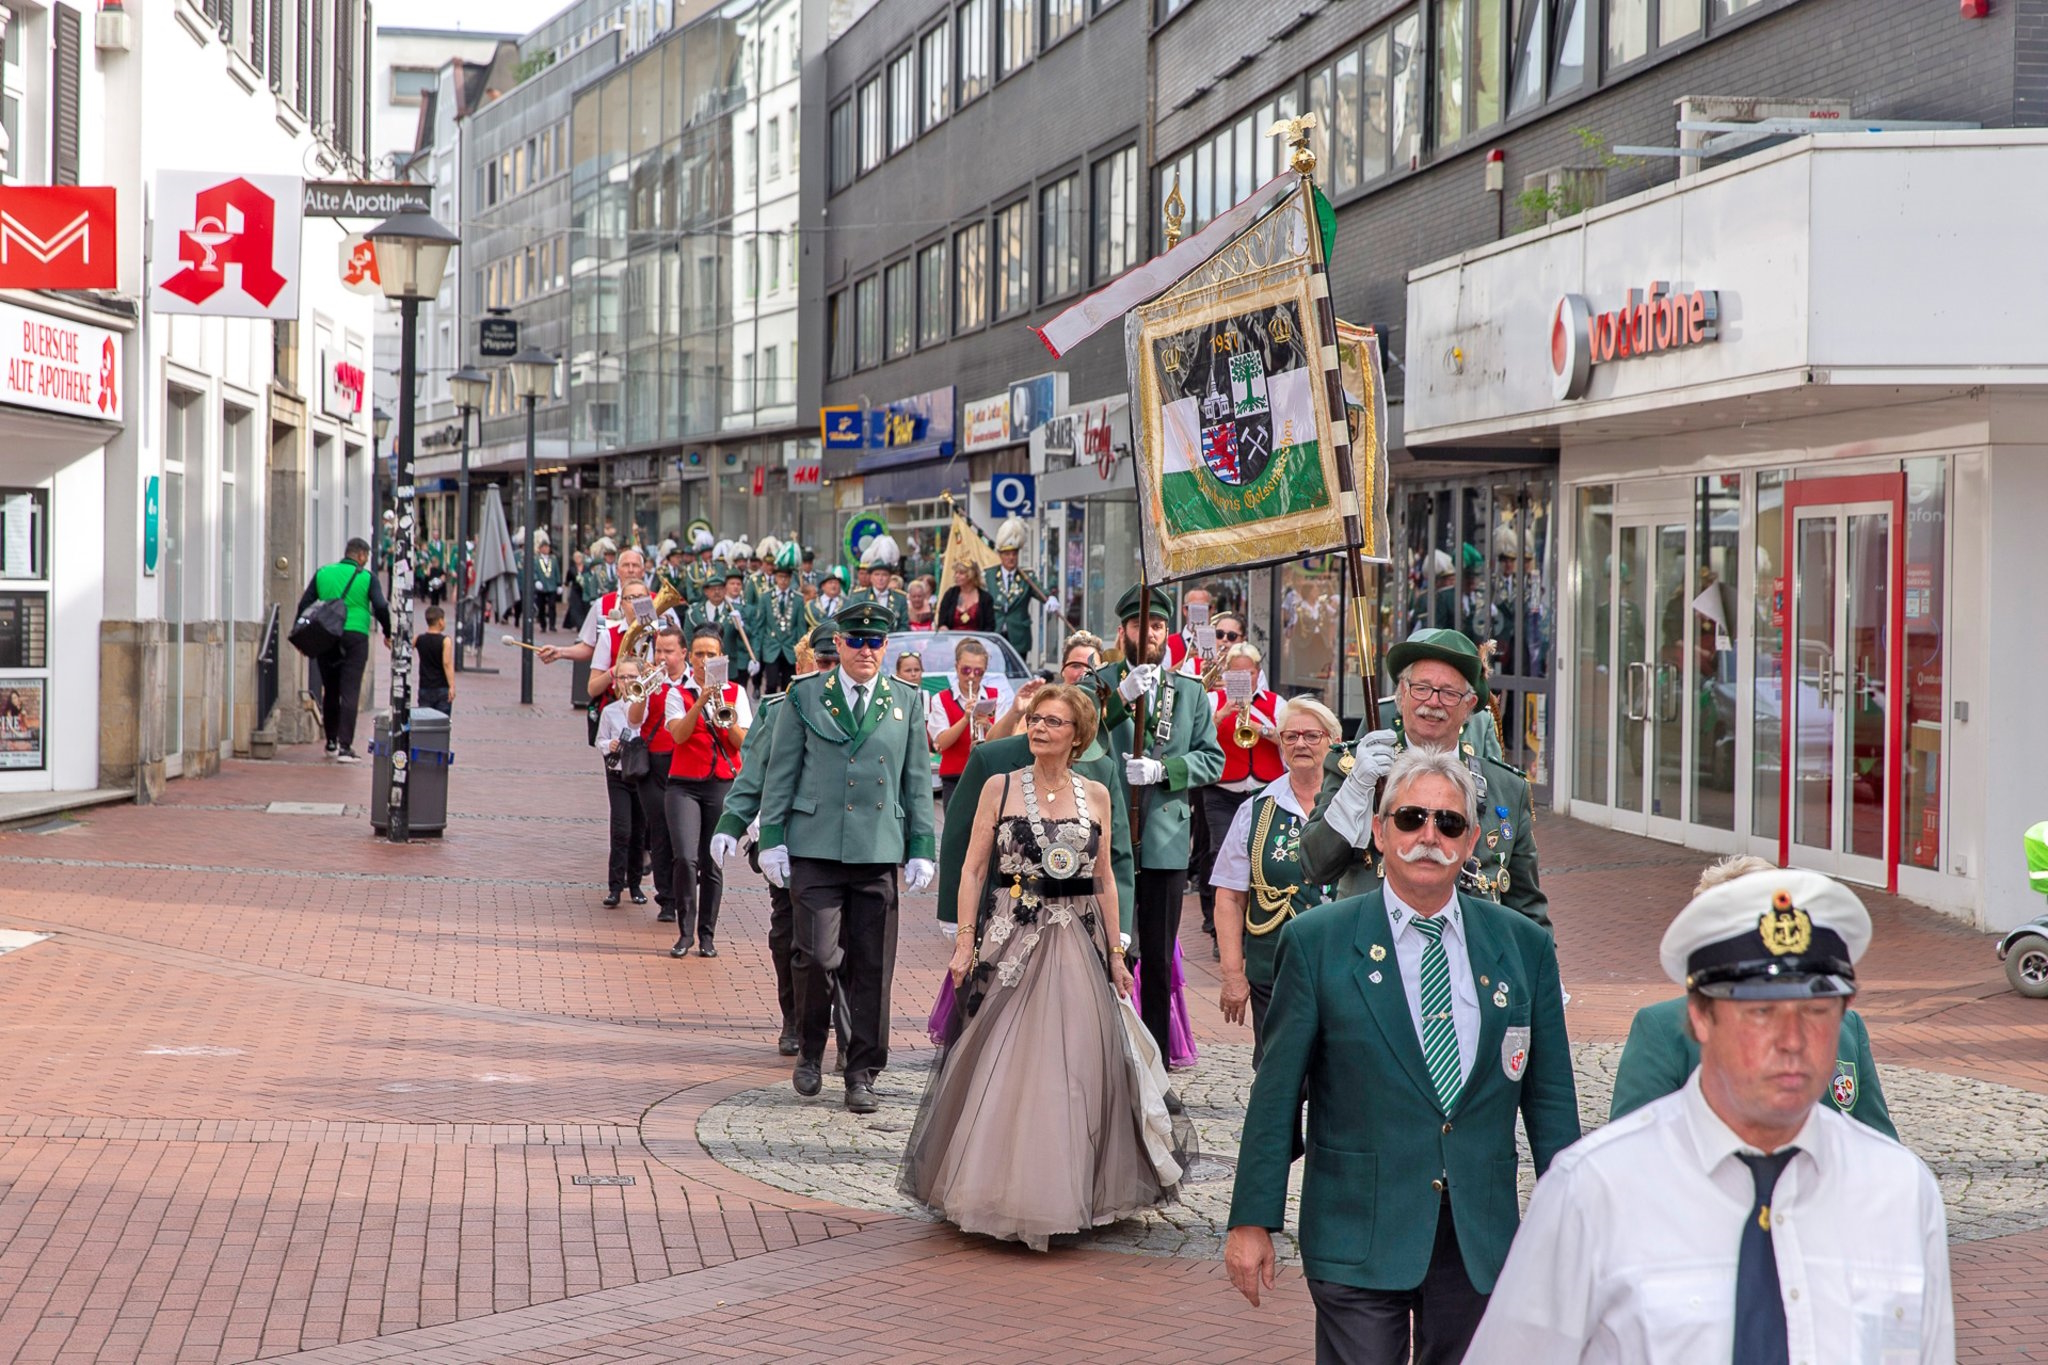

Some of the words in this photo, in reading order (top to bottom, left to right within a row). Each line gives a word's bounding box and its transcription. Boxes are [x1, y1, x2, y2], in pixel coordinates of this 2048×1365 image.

[1809, 111, 1840, 119] SANYO
[304, 188, 339, 211] Alte
[1588, 280, 1706, 362] vodafone
[24, 320, 79, 364] BUERSCHE
[8, 357, 34, 394] ALTE
[38, 363, 92, 405] APOTHEKE
[995, 477, 1032, 514] O2
